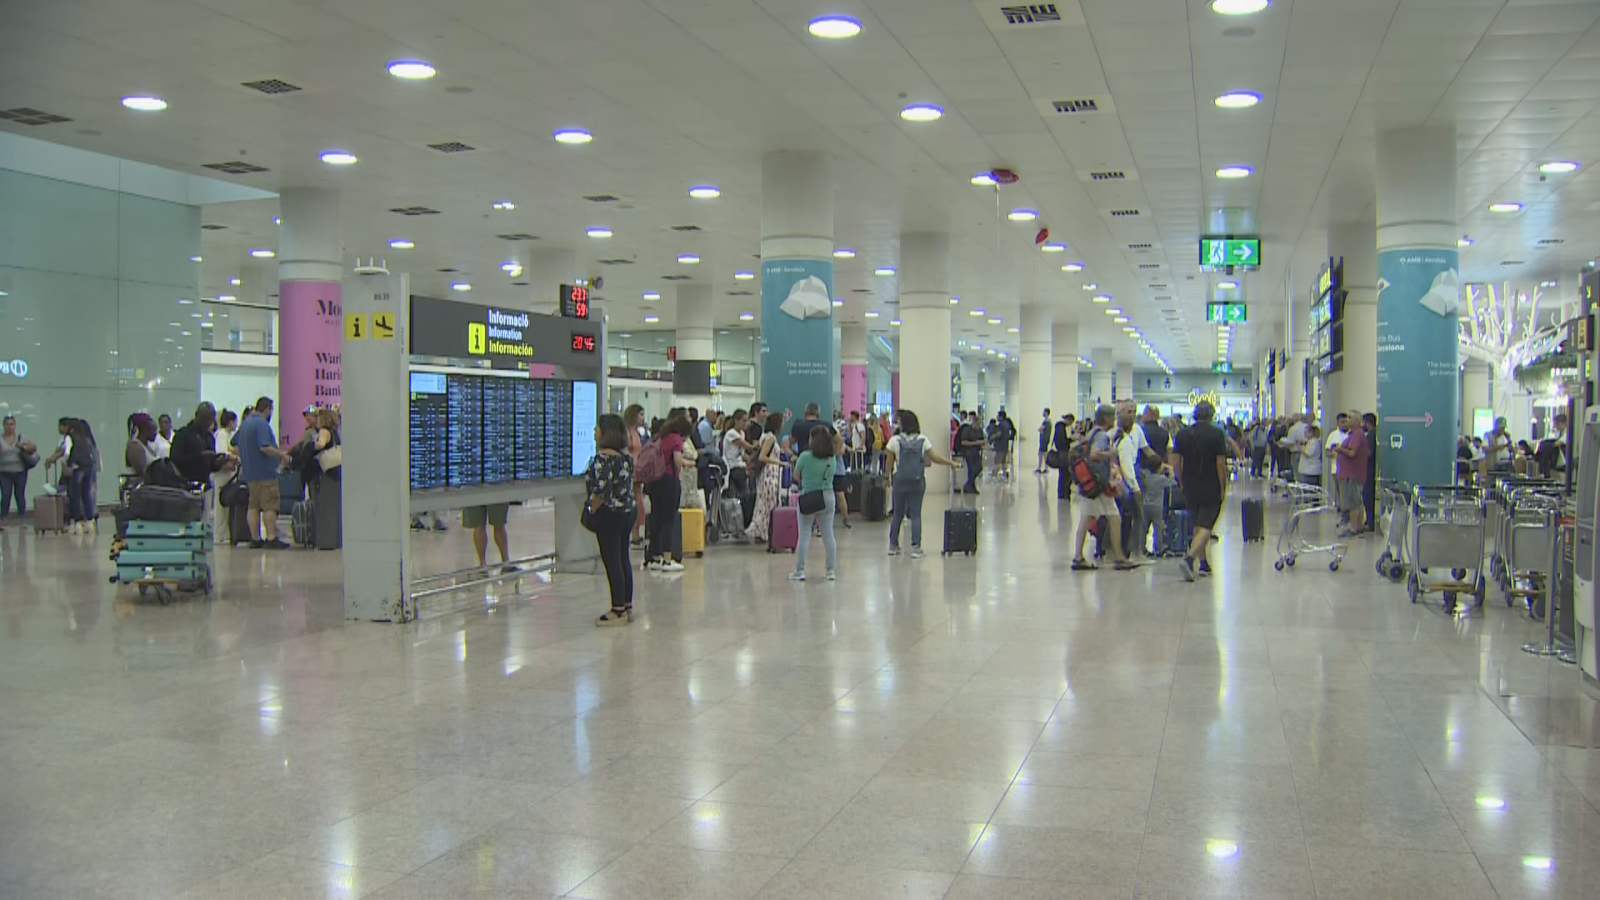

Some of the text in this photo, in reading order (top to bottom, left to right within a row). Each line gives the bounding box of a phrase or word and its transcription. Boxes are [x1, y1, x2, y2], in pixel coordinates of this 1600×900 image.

[488, 309, 529, 328] Informació
[488, 325, 522, 341] Information
[488, 339, 533, 357] Información
[786, 360, 797, 368] The
